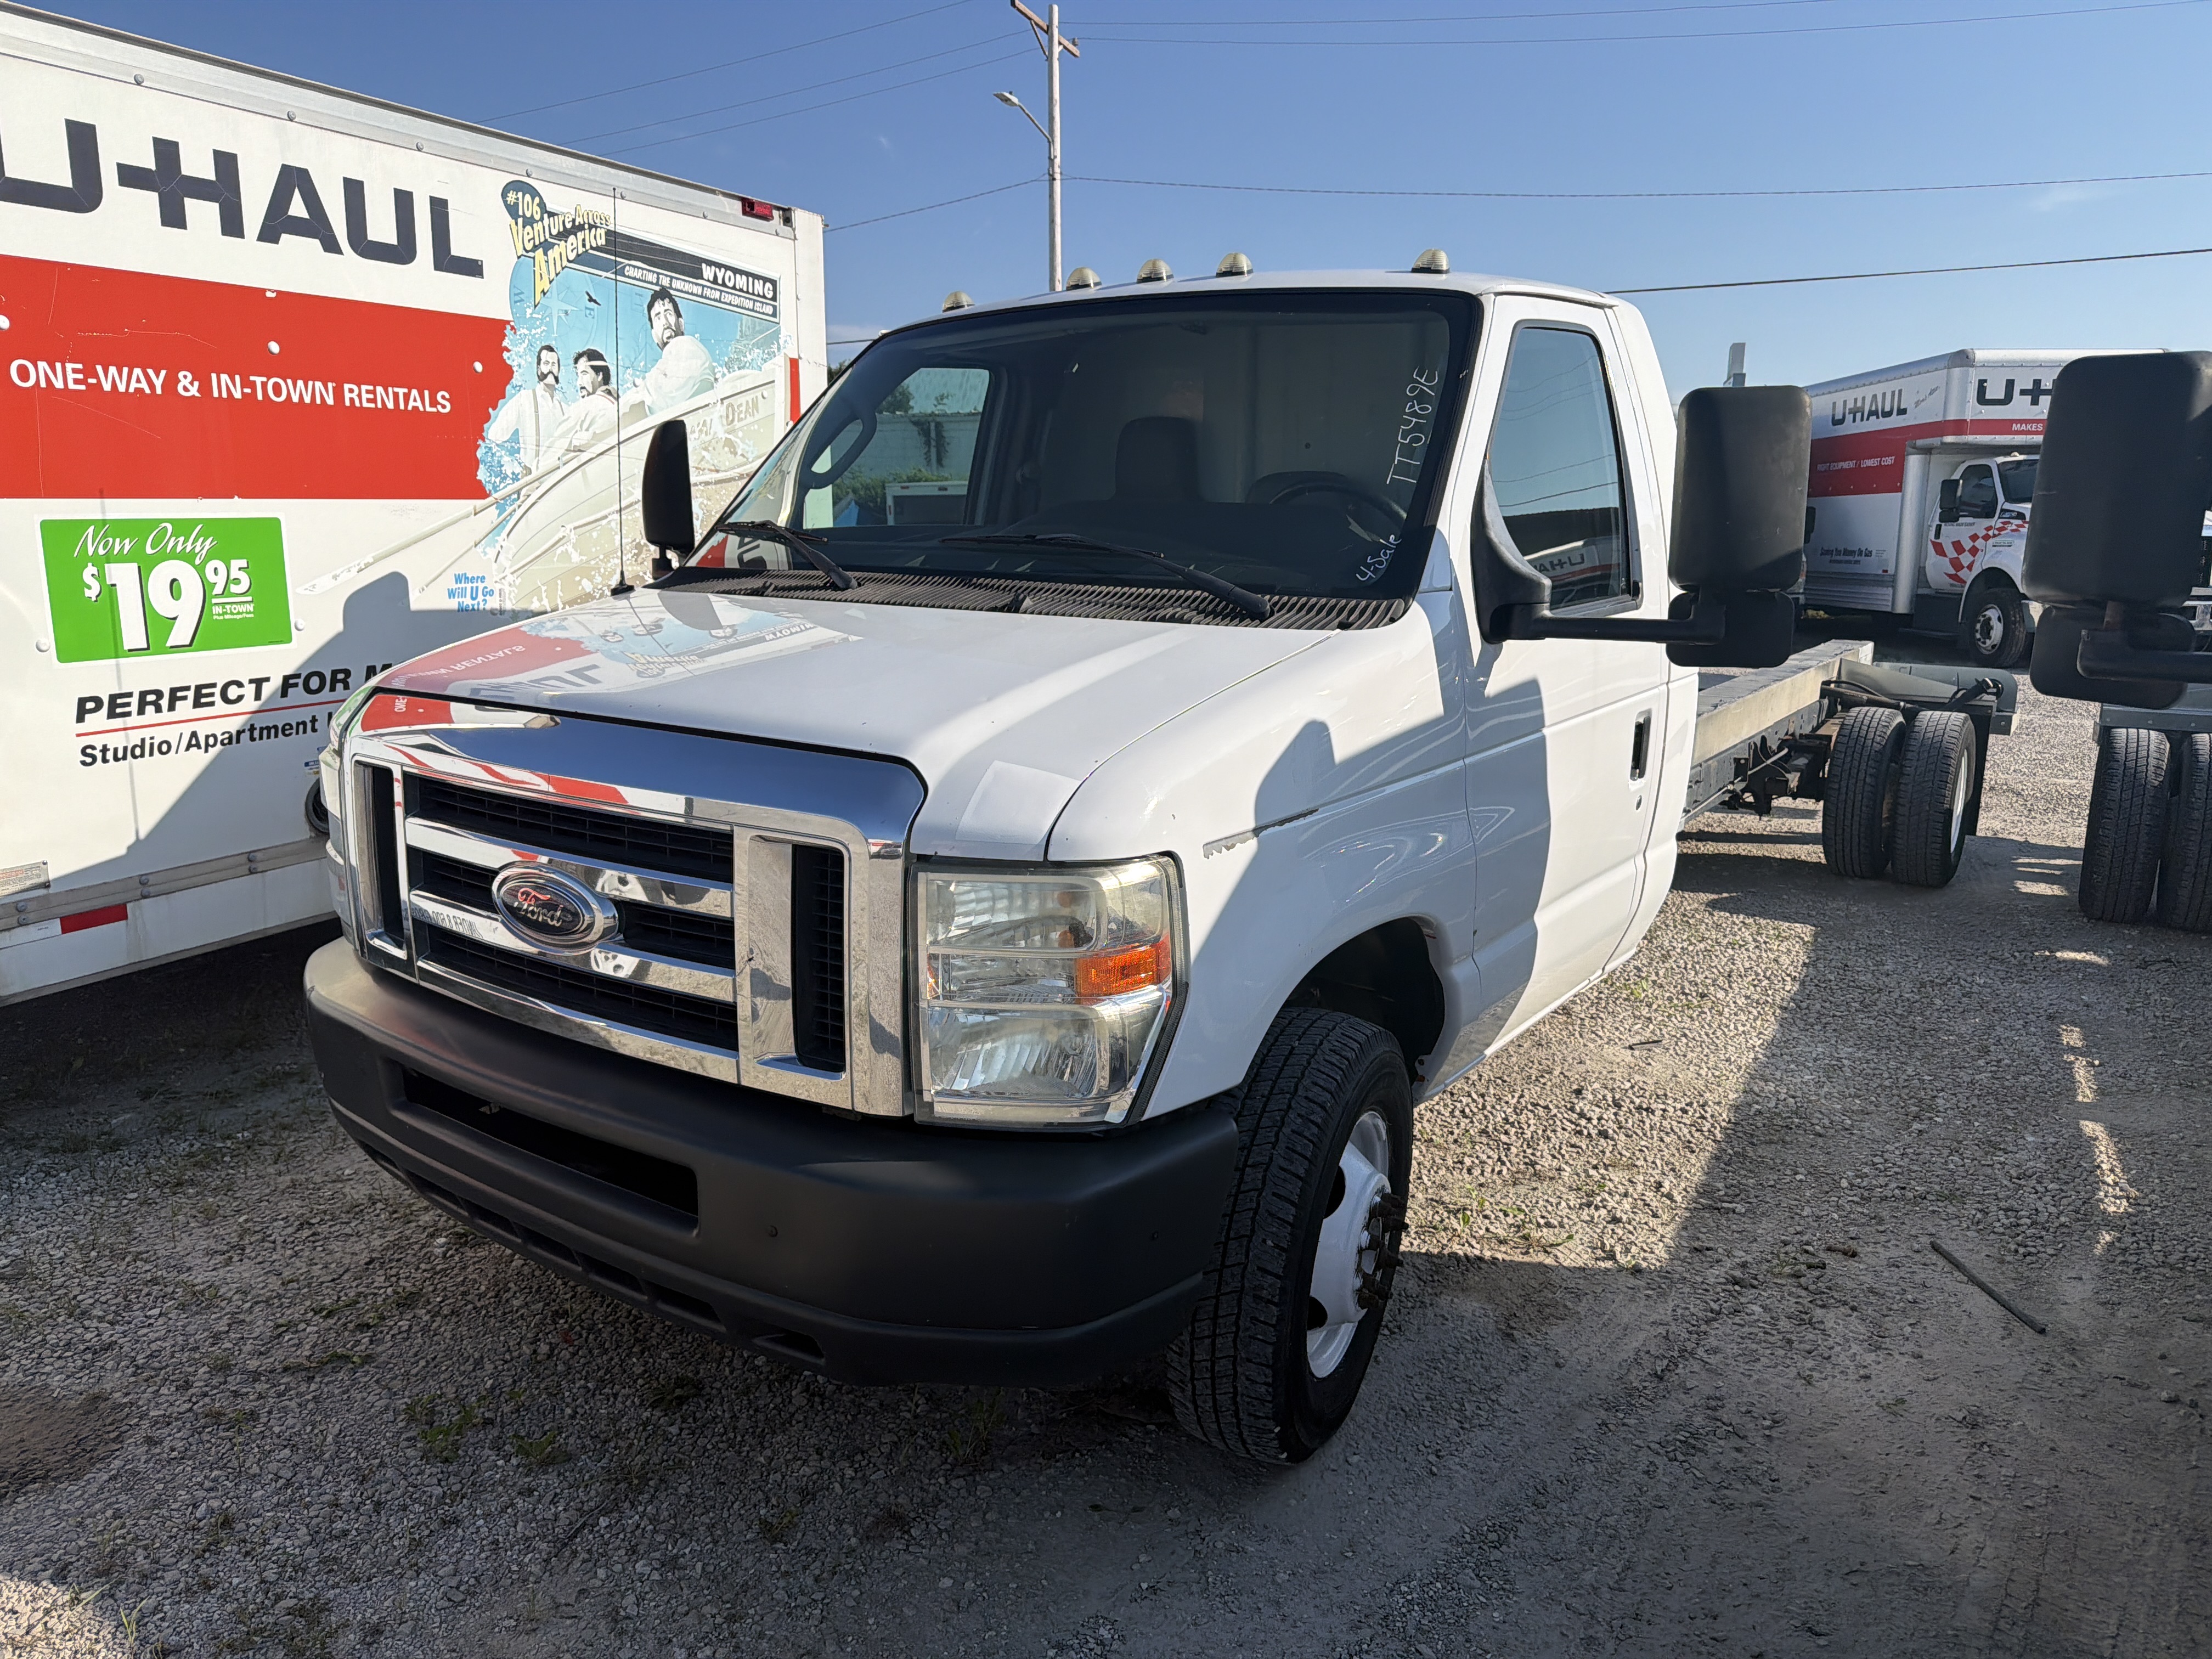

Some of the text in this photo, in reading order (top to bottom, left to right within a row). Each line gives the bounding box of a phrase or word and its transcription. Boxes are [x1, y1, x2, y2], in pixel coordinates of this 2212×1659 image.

[506, 190, 541, 221] #106
[510, 204, 611, 258] Venture Across
[534, 224, 606, 306] America
[702, 263, 774, 298] WYOMING
[624, 266, 774, 315] CHARTING THE UNKNOWN FROM EXPEDITION ISLAND
[9, 359, 451, 413] ONE-WAY & IN-TOWN RENTALS
[725, 395, 759, 426] DEAN
[1386, 366, 1439, 484] TT5489E
[1831, 388, 1908, 426] U-HAUL
[2012, 423, 2043, 431] MAKES
[1830, 460, 1857, 471] EQUIPMENT
[1860, 458, 1881, 467] LOWEST
[1881, 456, 1895, 466] COST
[73, 522, 218, 567] Now Only
[447, 586, 494, 601] Will U Go
[454, 572, 486, 585] Where
[212, 604, 254, 614] IN-TOWN
[457, 599, 488, 612] Next?
[76, 676, 270, 724] PERFECT
[280, 668, 351, 698] FOR
[80, 713, 318, 766] Studio/Apartment
[514, 887, 564, 927] Ford
